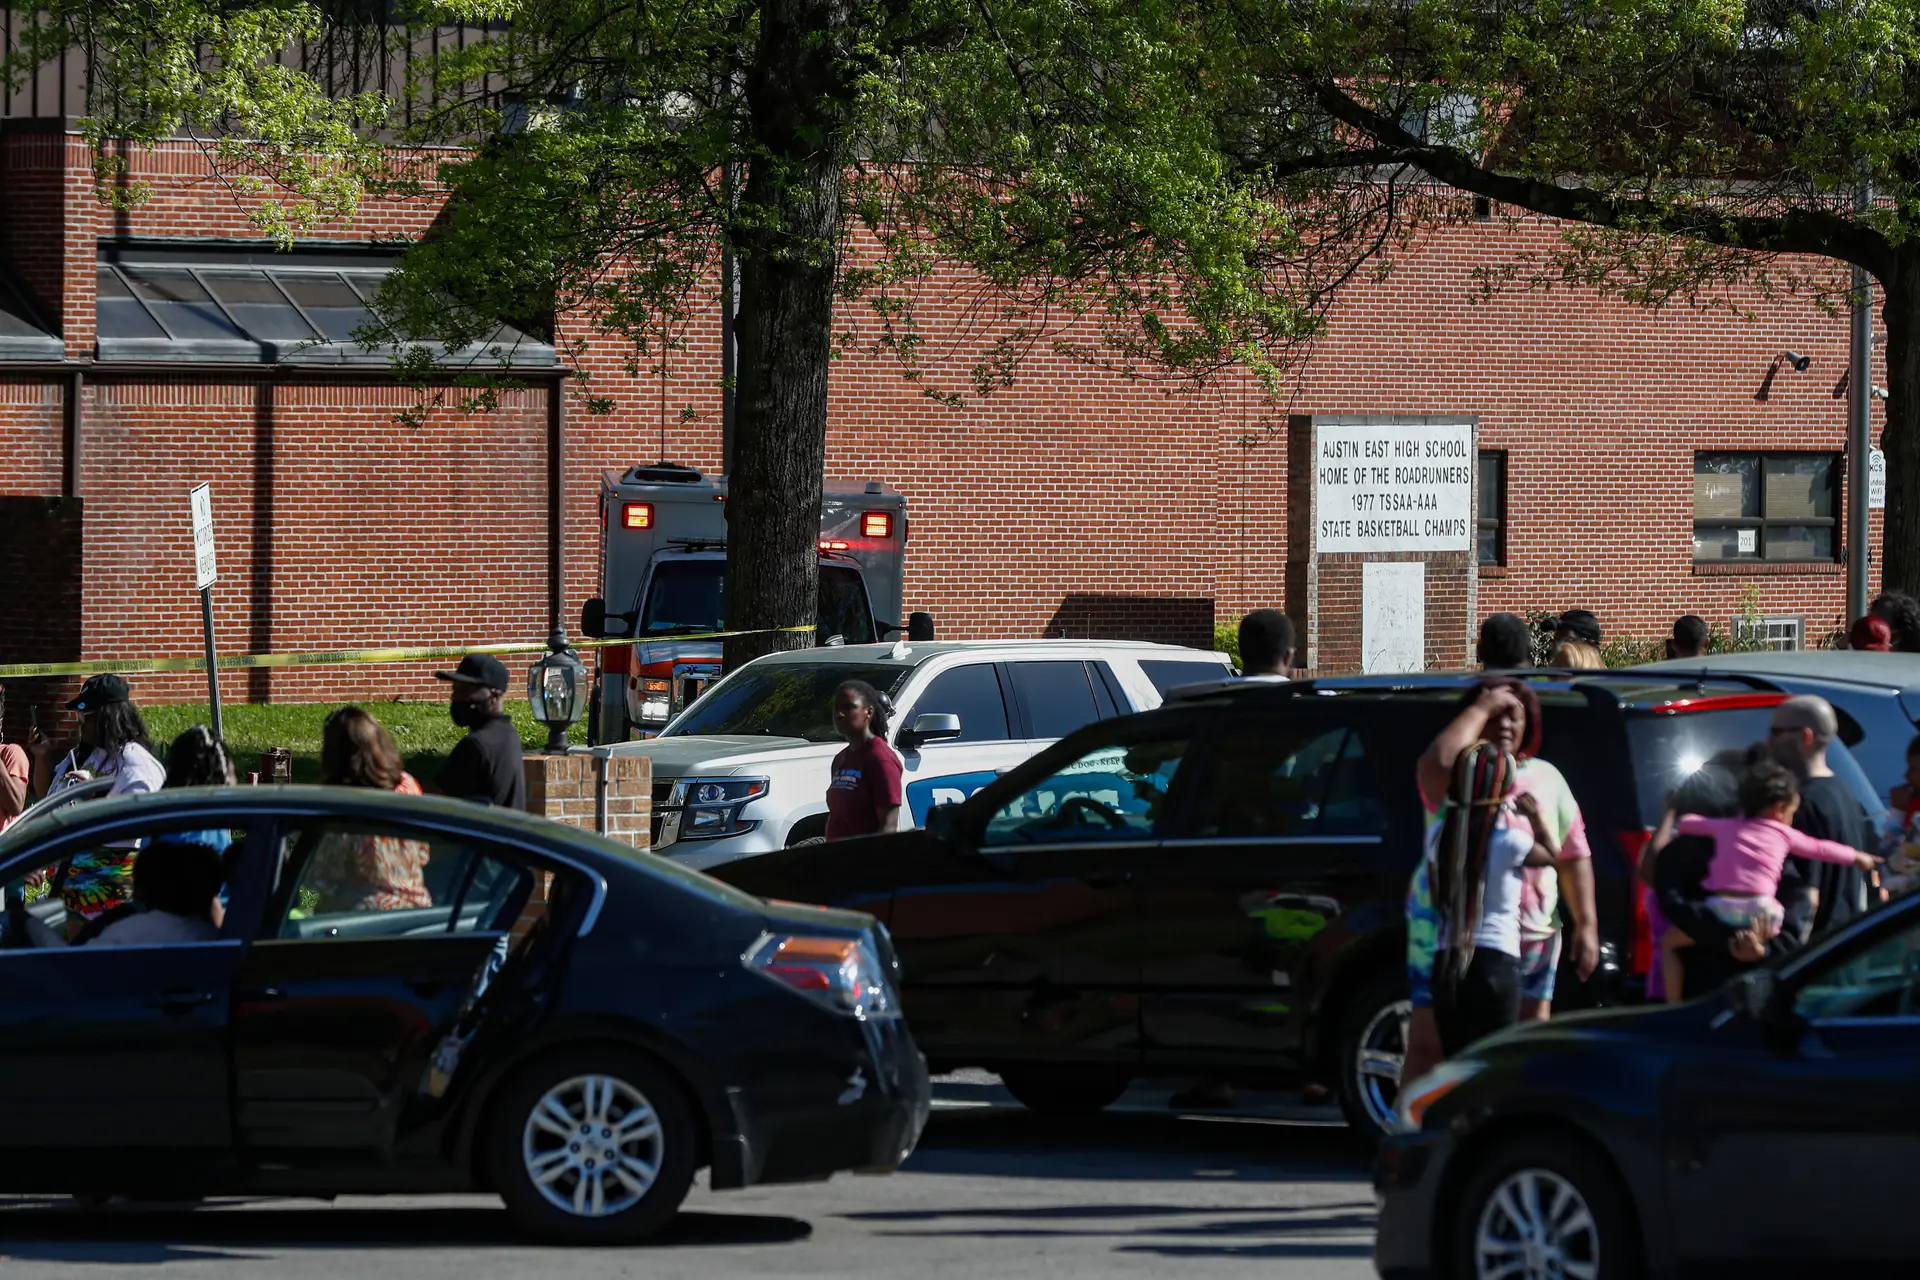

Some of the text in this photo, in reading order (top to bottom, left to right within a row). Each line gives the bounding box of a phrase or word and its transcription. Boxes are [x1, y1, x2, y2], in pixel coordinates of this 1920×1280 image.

[1322, 440, 1467, 458] AUSTIN EAST HIGH SCHOOL
[1319, 467, 1469, 485] HOME OF THE ROADRUNNERS
[1869, 464, 1883, 472] KCS
[1351, 493, 1438, 511] 1977 TSSAA-AAA
[1321, 519, 1466, 538] STATE BASKETBALL CHAMPS
